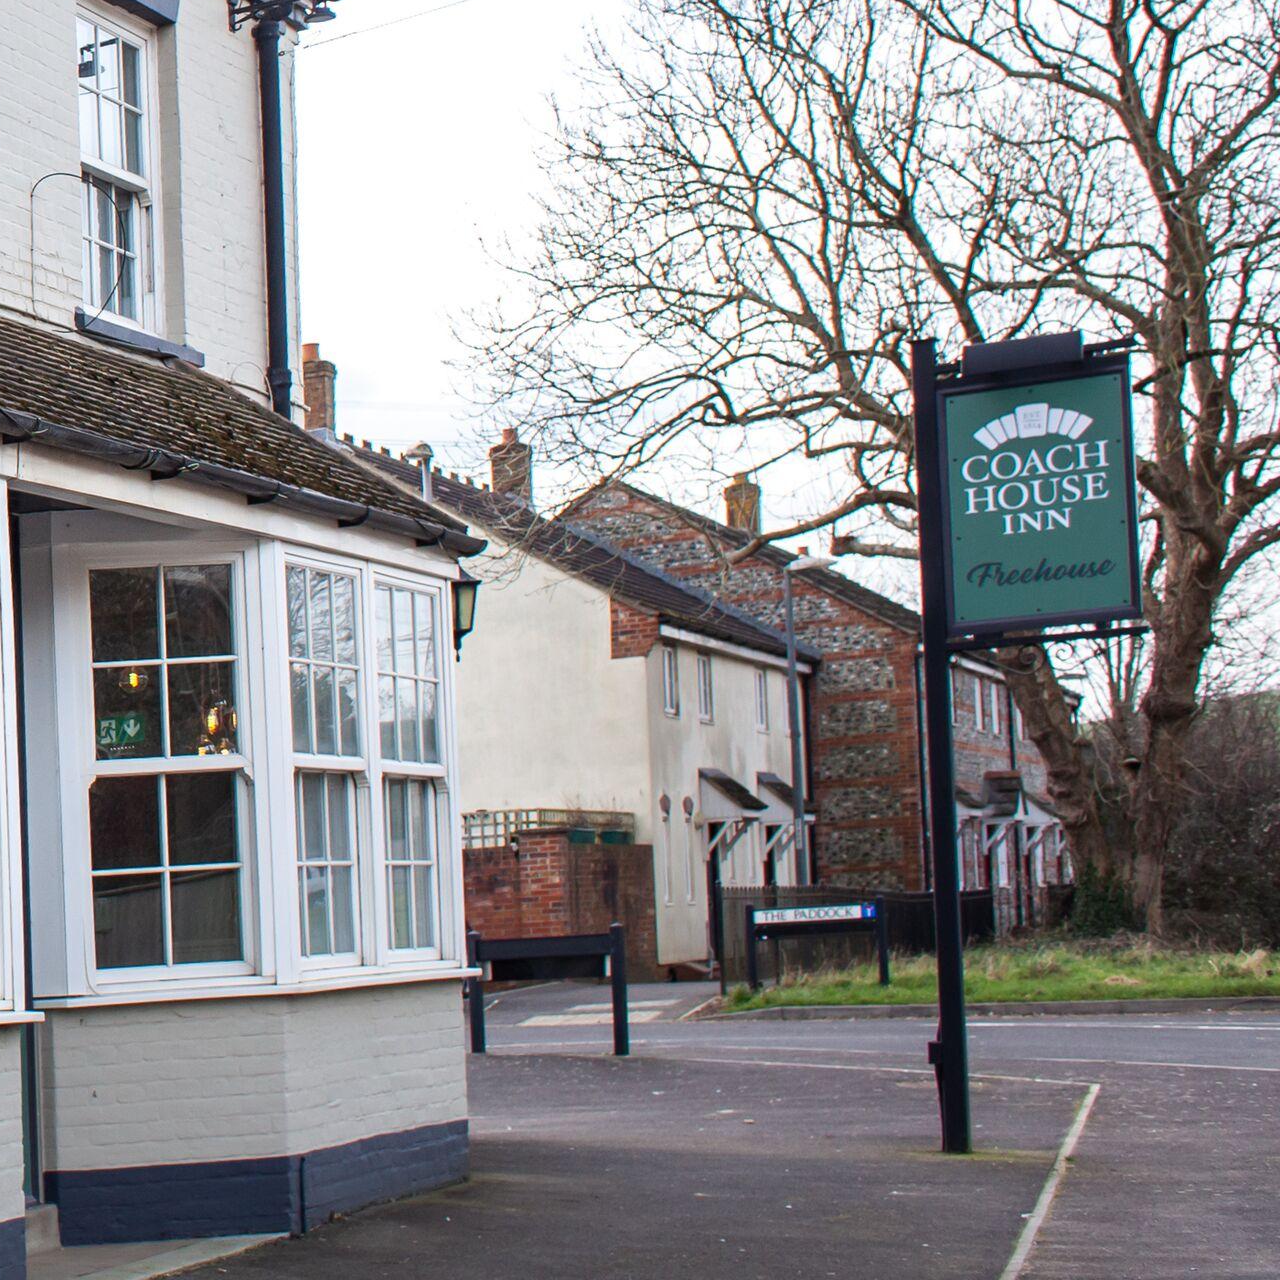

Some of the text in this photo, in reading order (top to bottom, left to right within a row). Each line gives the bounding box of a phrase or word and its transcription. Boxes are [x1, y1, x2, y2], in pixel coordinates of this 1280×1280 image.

[961, 439, 1110, 484] COACH
[964, 472, 1110, 515] HOUSE
[1002, 507, 1072, 535] INN
[966, 558, 1117, 588] Freehouse
[763, 907, 853, 922] THE PADDOCK
